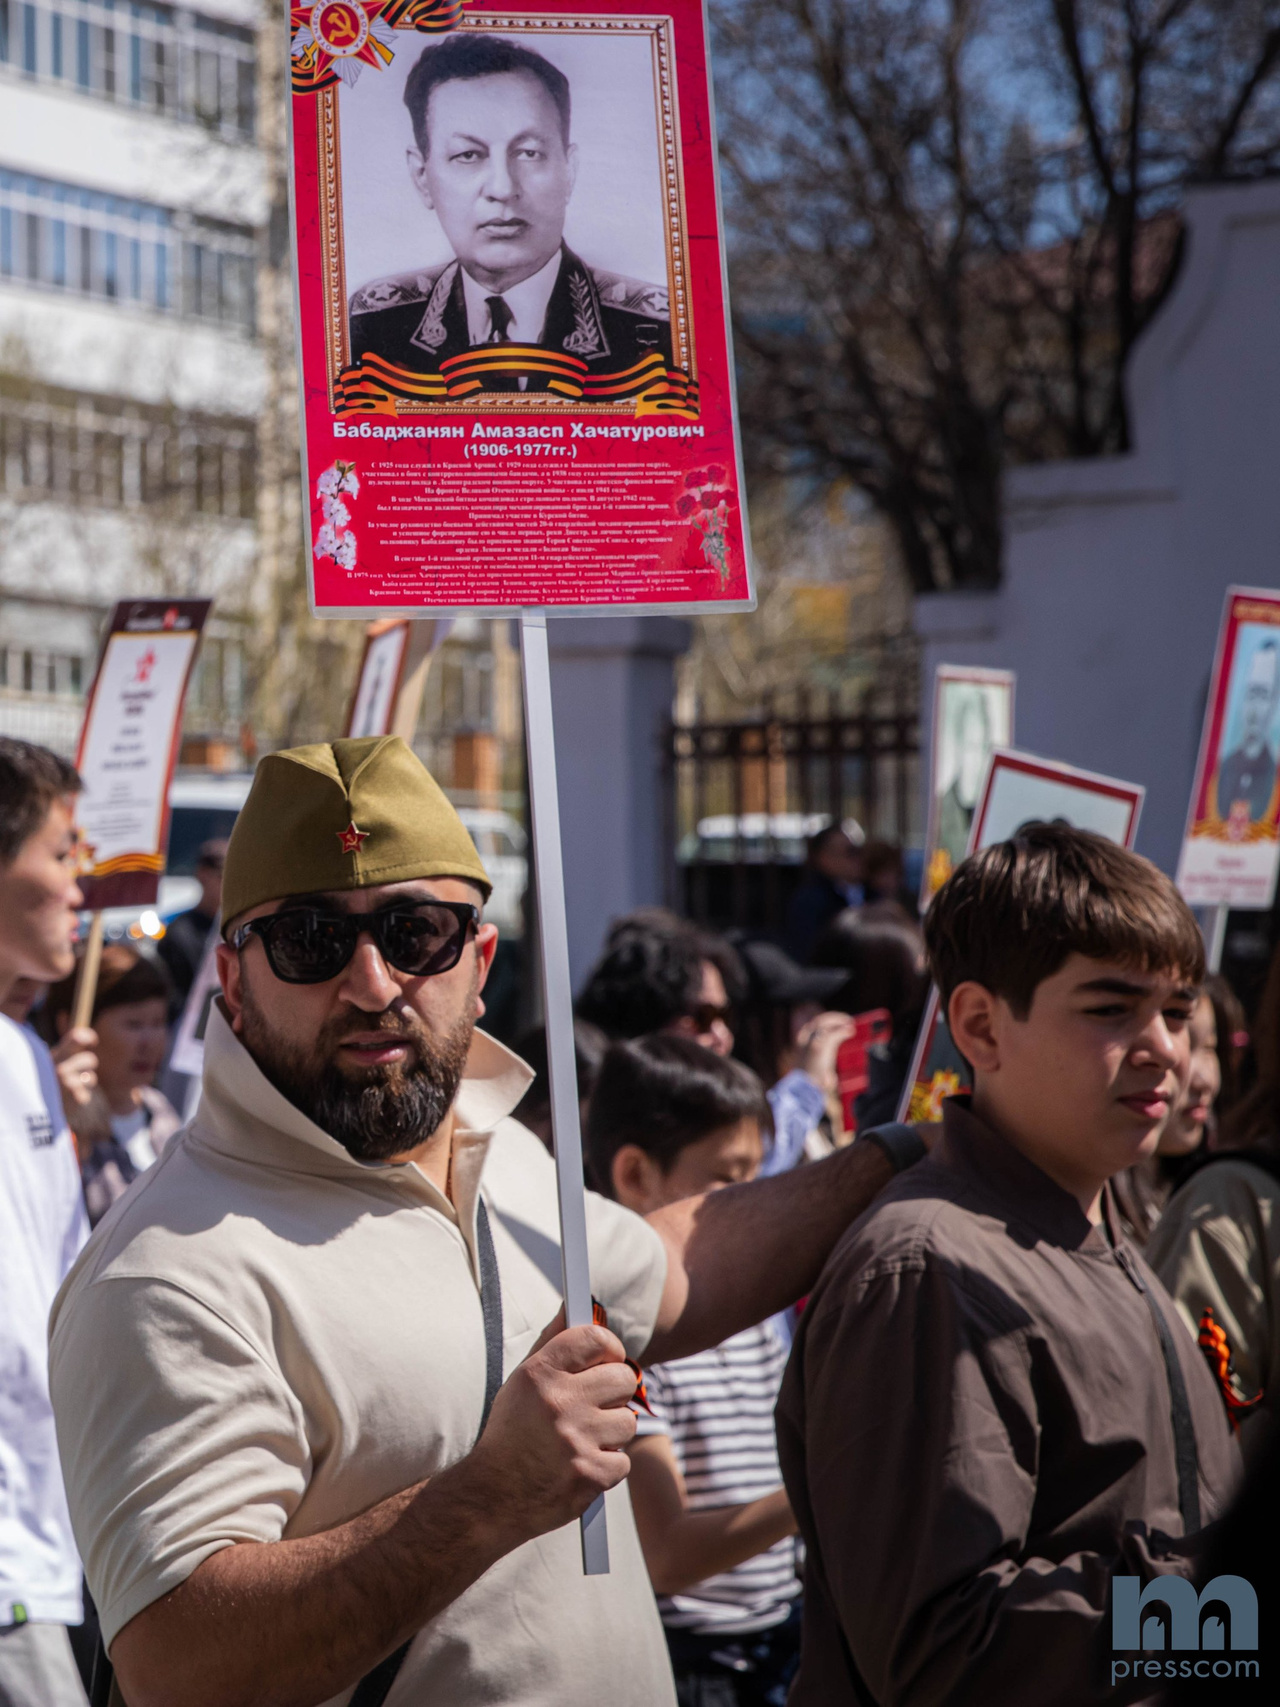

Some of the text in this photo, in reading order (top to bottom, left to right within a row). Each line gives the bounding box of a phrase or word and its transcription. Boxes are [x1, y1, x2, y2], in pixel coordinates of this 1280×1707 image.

[333, 422, 705, 441] Бабаджанян Амазасп Хачатурович
[463, 443, 578, 459] (1906-1977гг.)
